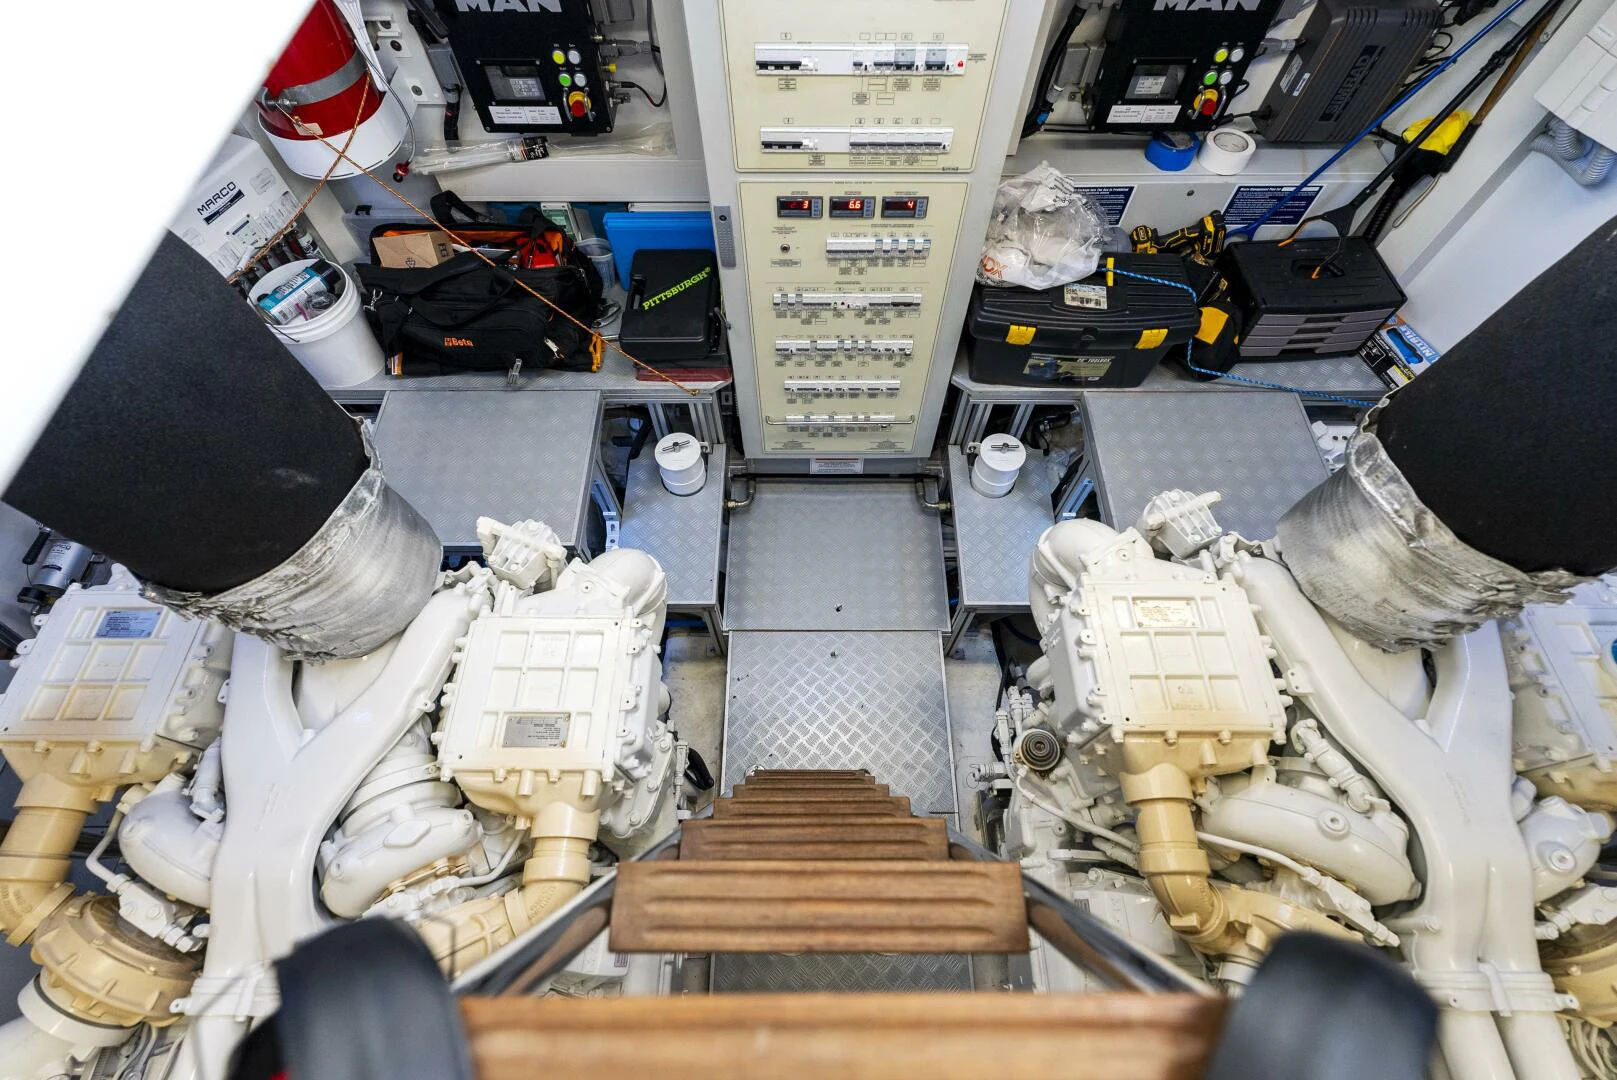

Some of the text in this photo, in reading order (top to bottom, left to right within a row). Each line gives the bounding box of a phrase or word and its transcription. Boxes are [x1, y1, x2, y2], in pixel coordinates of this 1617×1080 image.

[454, 0, 563, 13] MAN
[1152, 0, 1261, 11] MAN
[1325, 53, 1371, 116] SIMRAD
[196, 181, 237, 216] MARCO
[803, 200, 809, 209] 3
[907, 200, 914, 209] 4
[642, 268, 707, 311] PITTSBURGH
[451, 337, 474, 347] Beta
